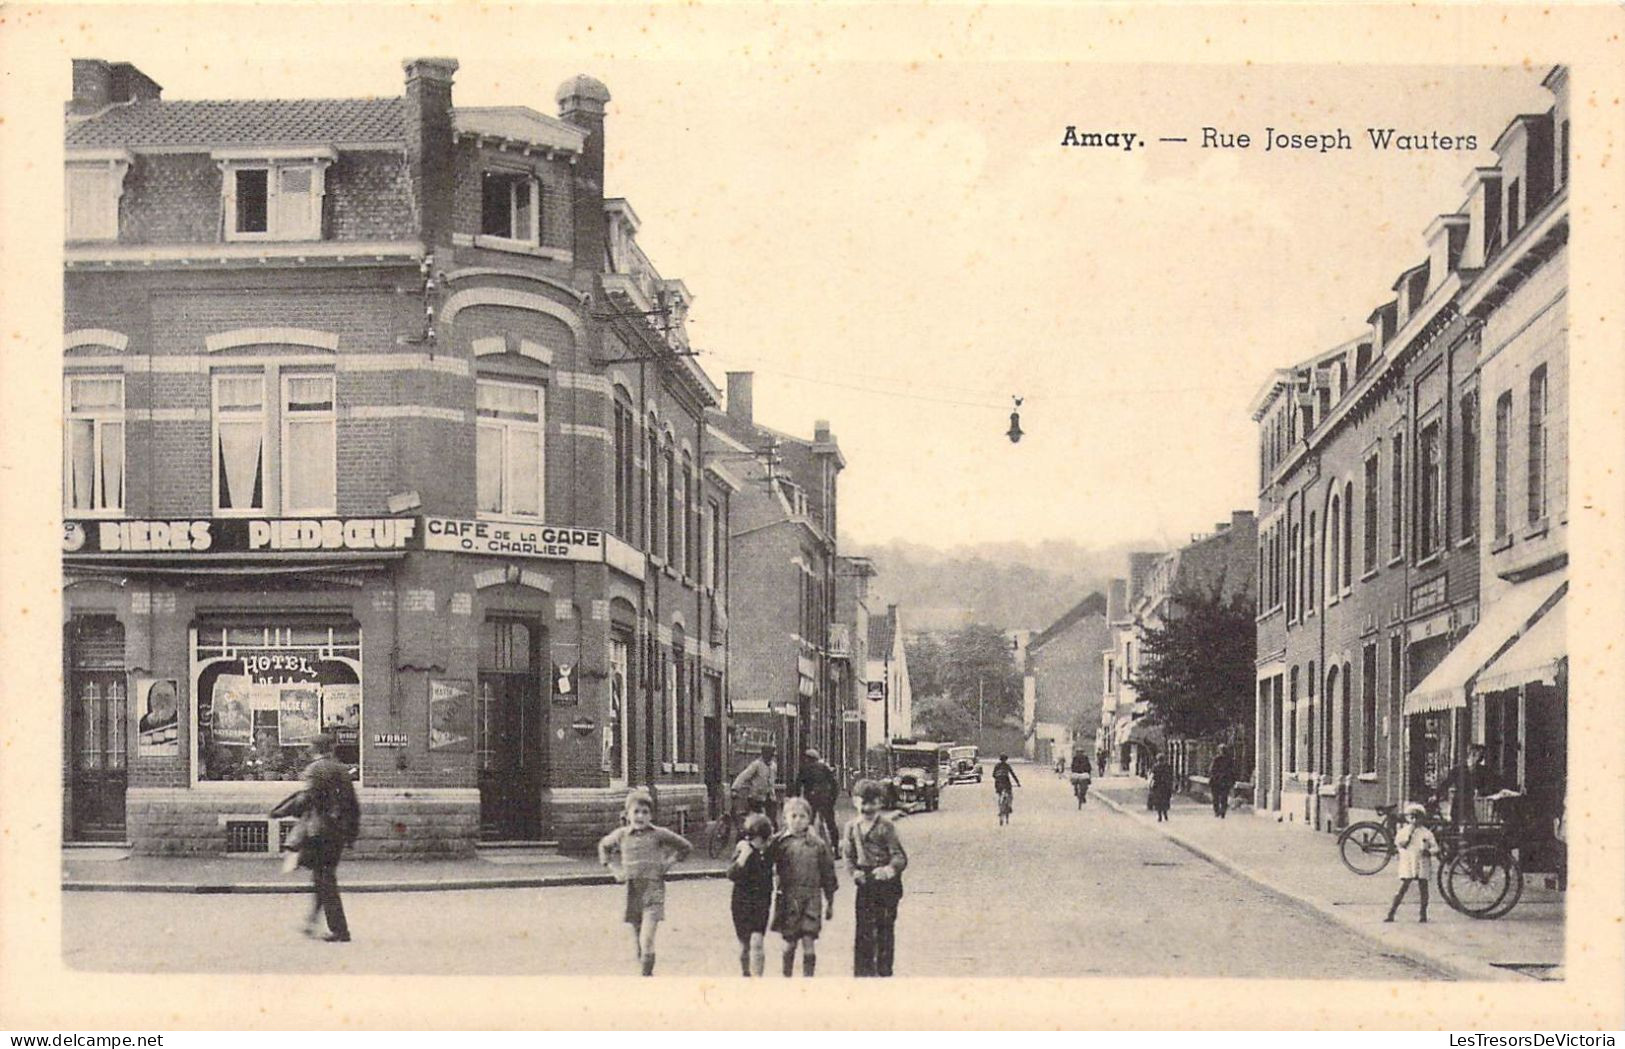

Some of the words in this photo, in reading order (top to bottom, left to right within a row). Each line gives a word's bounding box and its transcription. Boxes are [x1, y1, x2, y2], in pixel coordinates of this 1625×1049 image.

[428, 520, 489, 539] CAFE
[494, 531, 510, 540] DE
[520, 532, 537, 542] LA
[542, 529, 600, 547] GARE
[461, 539, 479, 550] O.
[488, 540, 569, 556] CHARLIER
[240, 655, 318, 678] HOTEL
